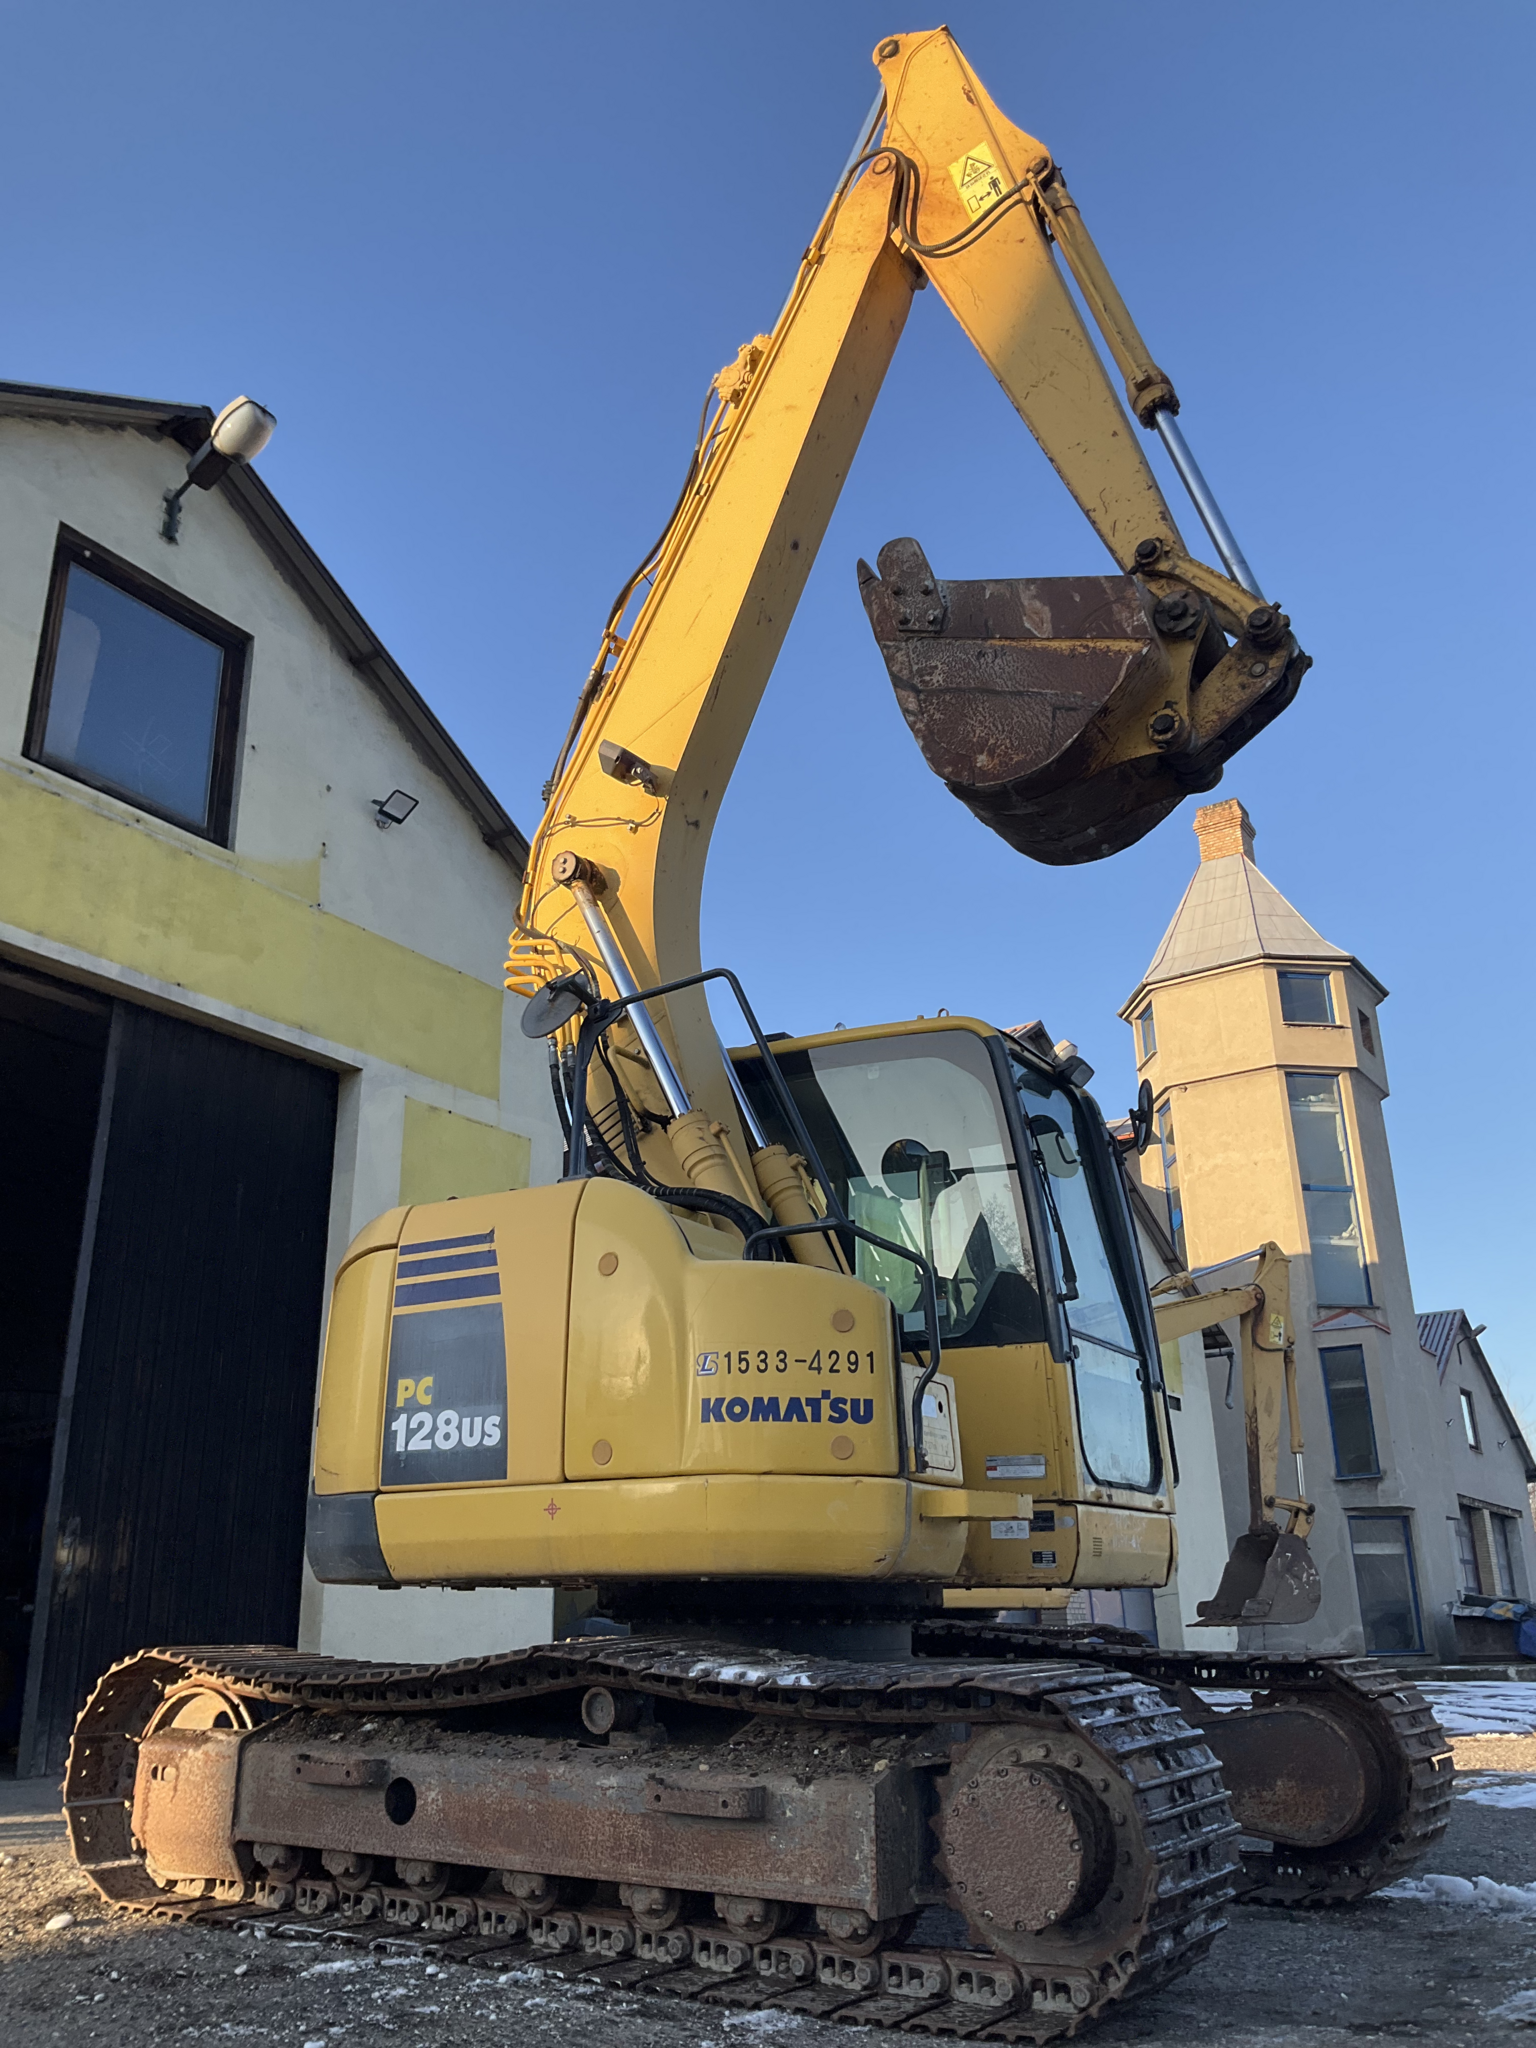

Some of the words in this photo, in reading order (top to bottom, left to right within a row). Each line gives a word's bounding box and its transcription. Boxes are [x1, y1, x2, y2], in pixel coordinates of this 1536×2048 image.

[724, 1350, 875, 1374] 1533-4291
[397, 1376, 433, 1407] PC
[701, 1389, 874, 1424] KOMATSU
[391, 1409, 501, 1452] 128US
